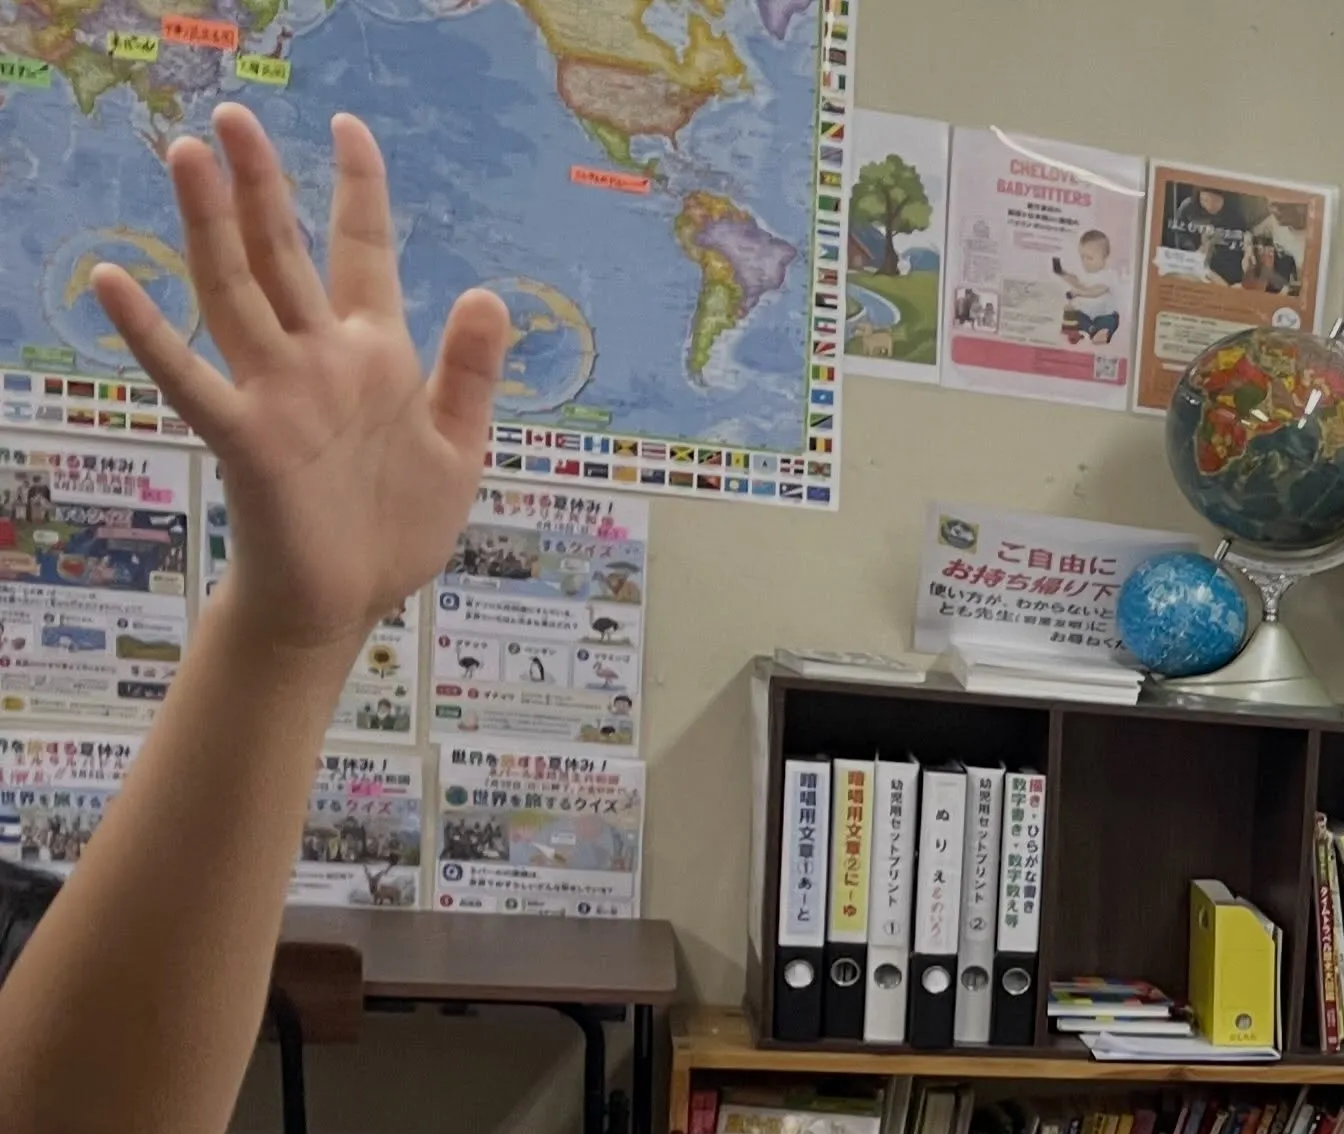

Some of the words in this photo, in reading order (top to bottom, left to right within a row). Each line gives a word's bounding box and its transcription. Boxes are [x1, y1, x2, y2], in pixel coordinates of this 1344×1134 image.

[996, 178, 1092, 207] BABYSITTERS
[941, 558, 1121, 602] お持ち帰り下
[887, 778, 904, 908] 幼児用セットプリント
[974, 777, 992, 904] 幼児用セットプリント
